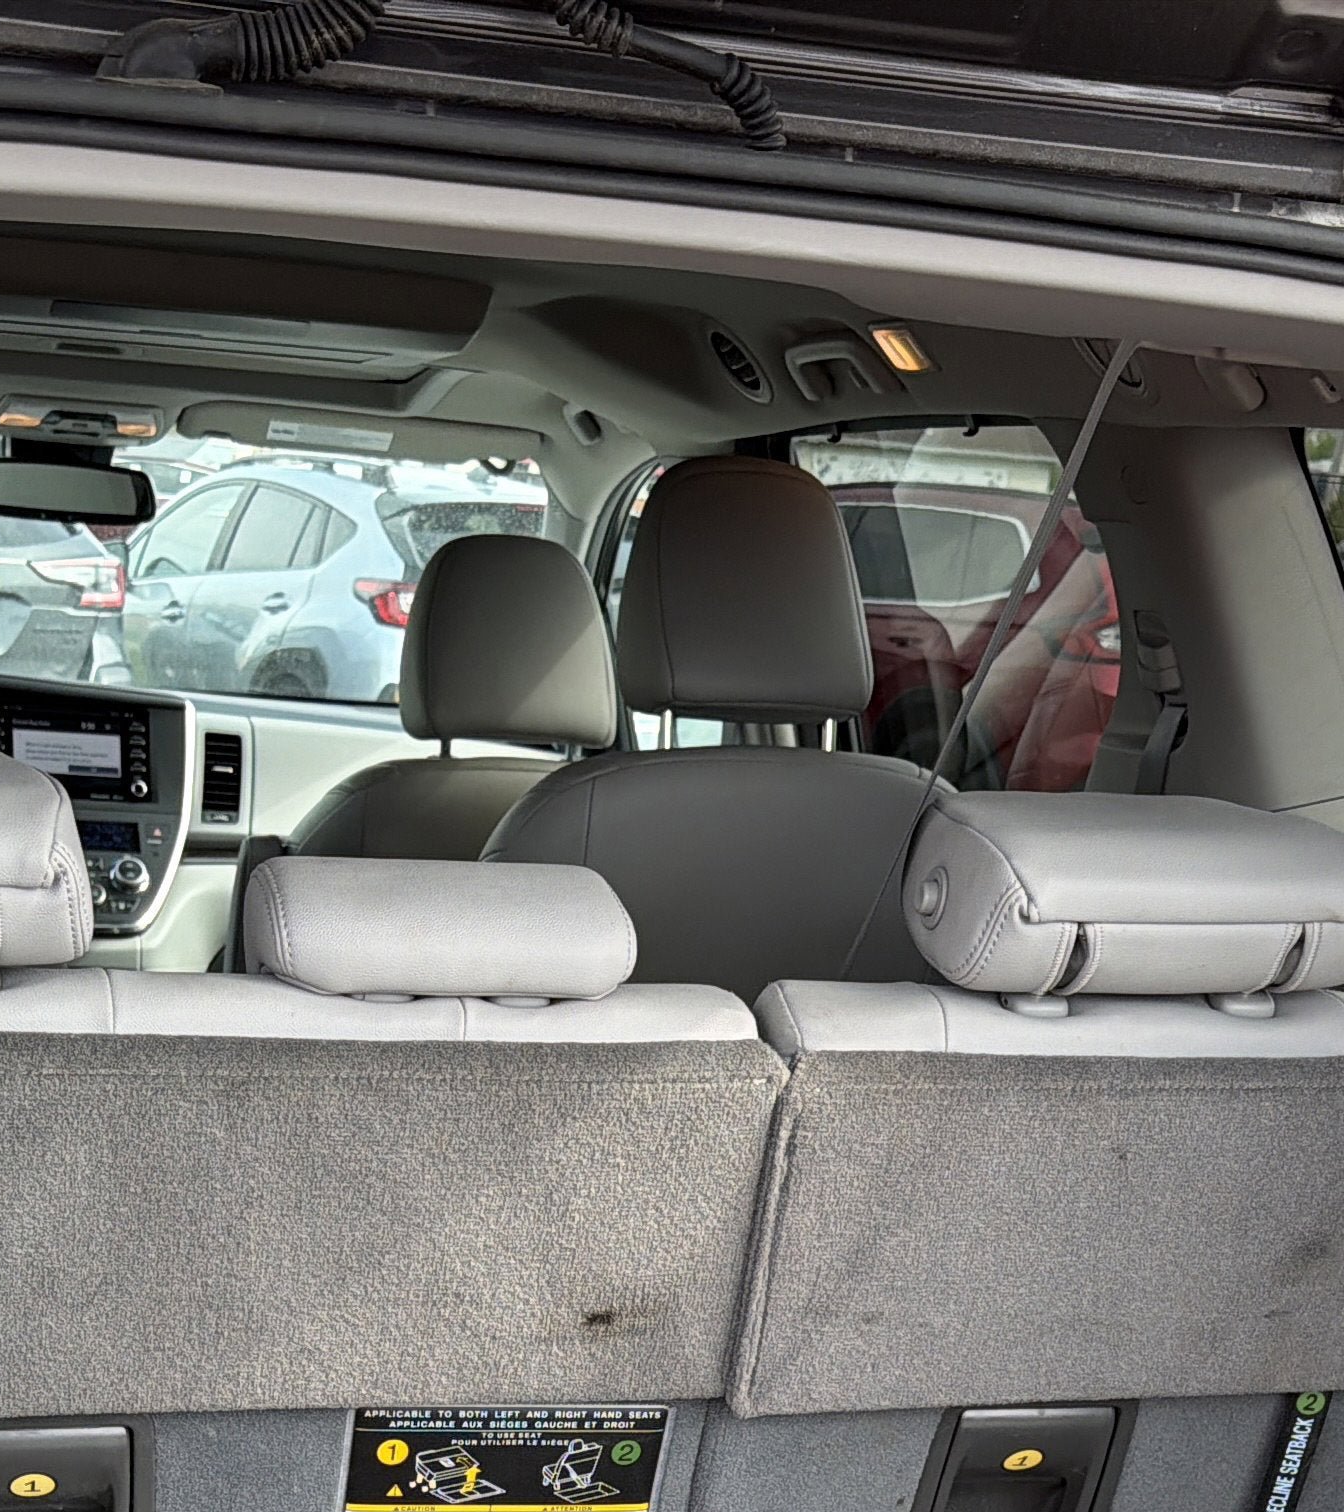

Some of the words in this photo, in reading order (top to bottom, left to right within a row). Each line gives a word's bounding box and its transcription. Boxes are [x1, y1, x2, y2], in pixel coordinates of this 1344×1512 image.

[1302, 1393, 1318, 1412] 2
[364, 1410, 432, 1419] APPLICABLE
[438, 1410, 452, 1419] TO
[458, 1410, 488, 1419] BOTH
[494, 1410, 520, 1419] LEFT
[526, 1410, 548, 1419] AND
[555, 1410, 588, 1419] RIGHT
[593, 1410, 622, 1419] HAND
[628, 1410, 662, 1419] SEATS
[388, 1420, 456, 1428] APPLICABLE
[462, 1420, 483, 1428] AUX
[534, 1420, 578, 1428] GAUCHE
[584, 1420, 597, 1428] ET
[387, 1444, 397, 1460] 1
[618, 1444, 633, 1461] 2
[1280, 1417, 1314, 1475] SEATBACK
